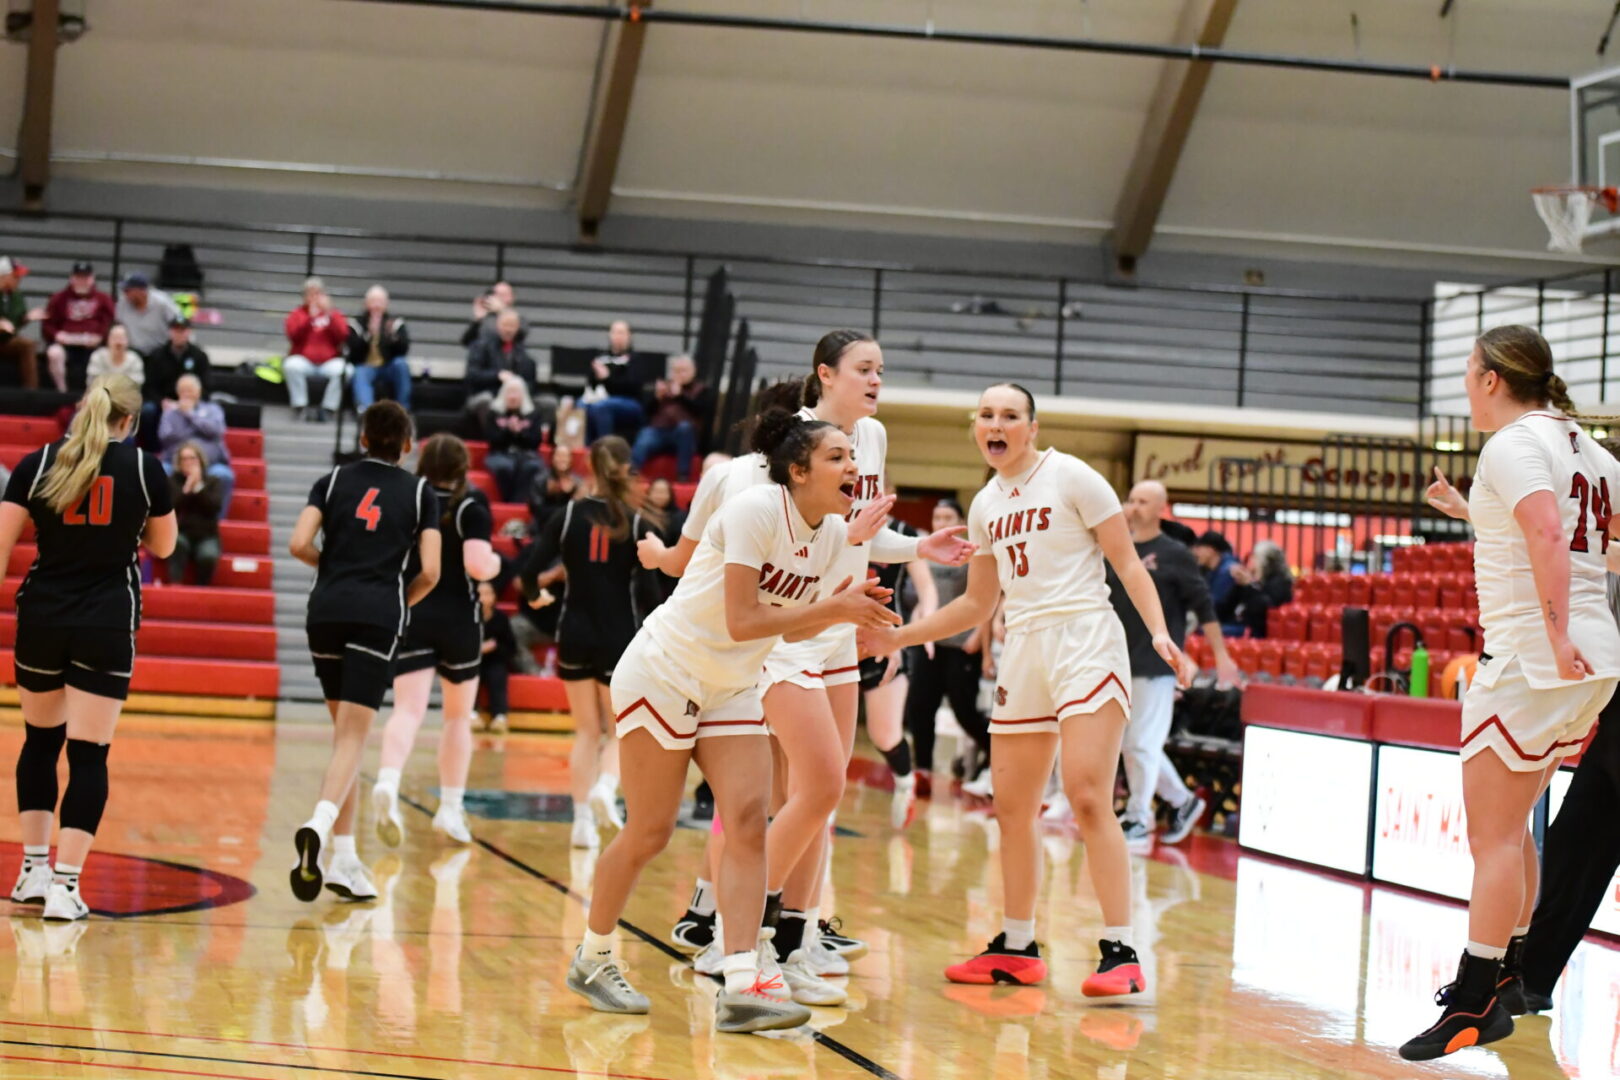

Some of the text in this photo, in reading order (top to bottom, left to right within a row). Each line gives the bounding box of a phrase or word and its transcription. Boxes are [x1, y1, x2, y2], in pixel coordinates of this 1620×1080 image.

[355, 487, 381, 531] 4
[988, 507, 1052, 545] SAINTS
[1569, 471, 1612, 555] 24
[1006, 541, 1029, 580] 13
